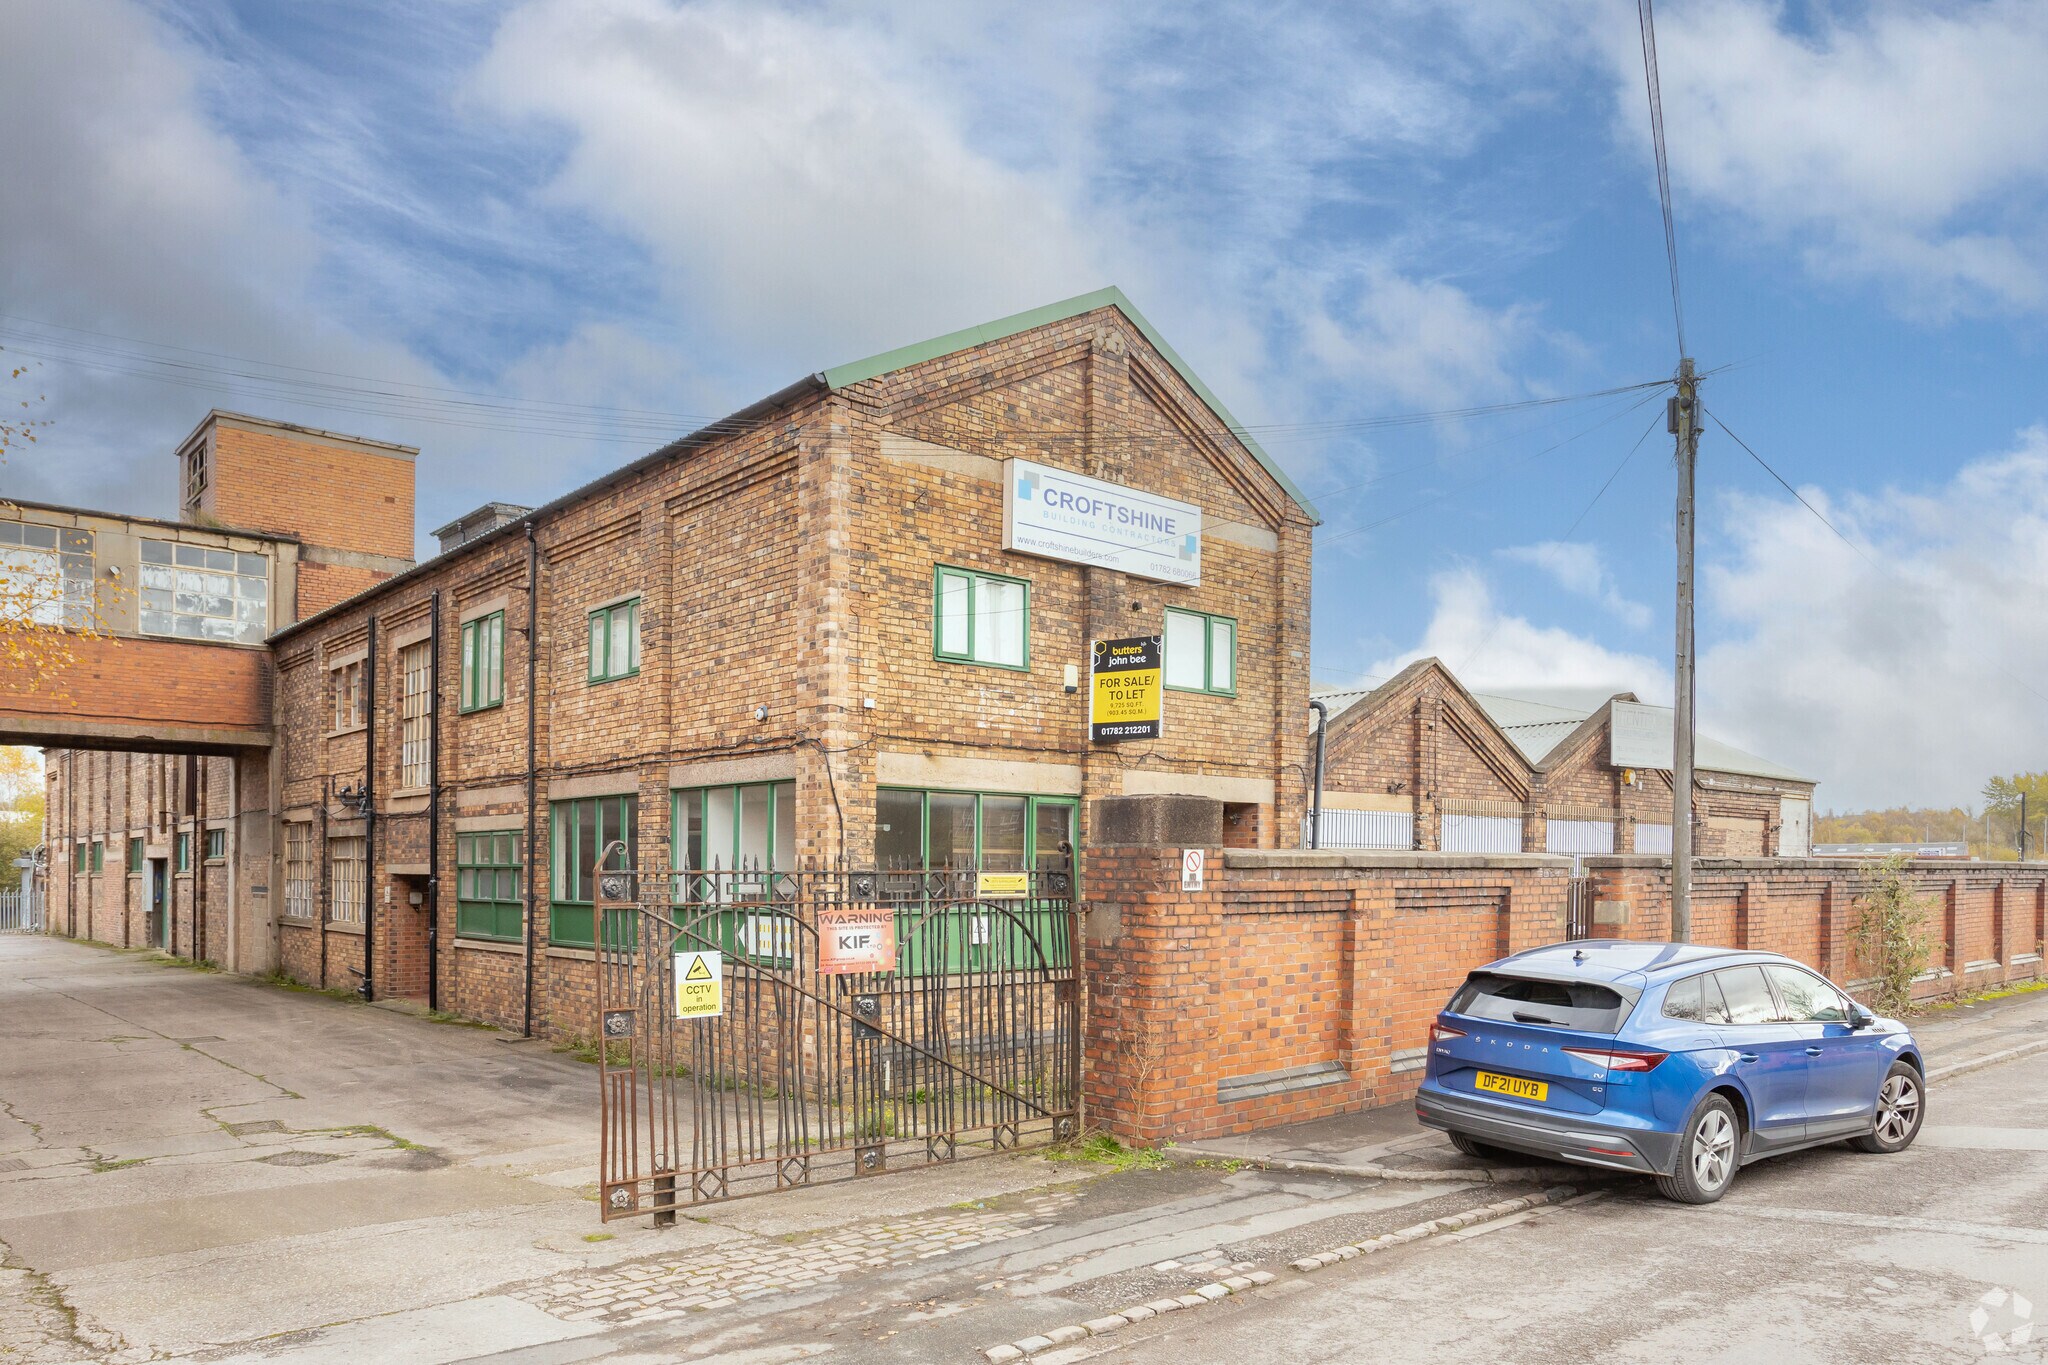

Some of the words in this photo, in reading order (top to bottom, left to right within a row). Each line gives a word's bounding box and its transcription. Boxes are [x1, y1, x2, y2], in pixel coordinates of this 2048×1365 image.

[1043, 488, 1176, 535] CROFTSHINE
[1043, 510, 1096, 529] BUILDING
[1102, 523, 1176, 547] CONTRACTORS
[1017, 535, 1120, 564] www.croftshinebuilders.com
[1150, 562, 1171, 575] 01782
[1112, 646, 1143, 656] butters
[1108, 656, 1128, 668] john
[1130, 654, 1147, 664] bee
[1100, 678, 1120, 688] FOR
[1124, 675, 1155, 687] SALE/
[1109, 690, 1123, 701] TO
[1126, 688, 1146, 700] LET
[1101, 727, 1124, 735] 01782
[1125, 725, 1151, 734] 212201
[820, 913, 893, 925] WARNING
[838, 935, 870, 949] KIF
[686, 985, 712, 995] CCTV
[682, 1004, 717, 1013] operation
[1483, 1075, 1511, 1092] DF21
[1513, 1079, 1539, 1096] UYB
